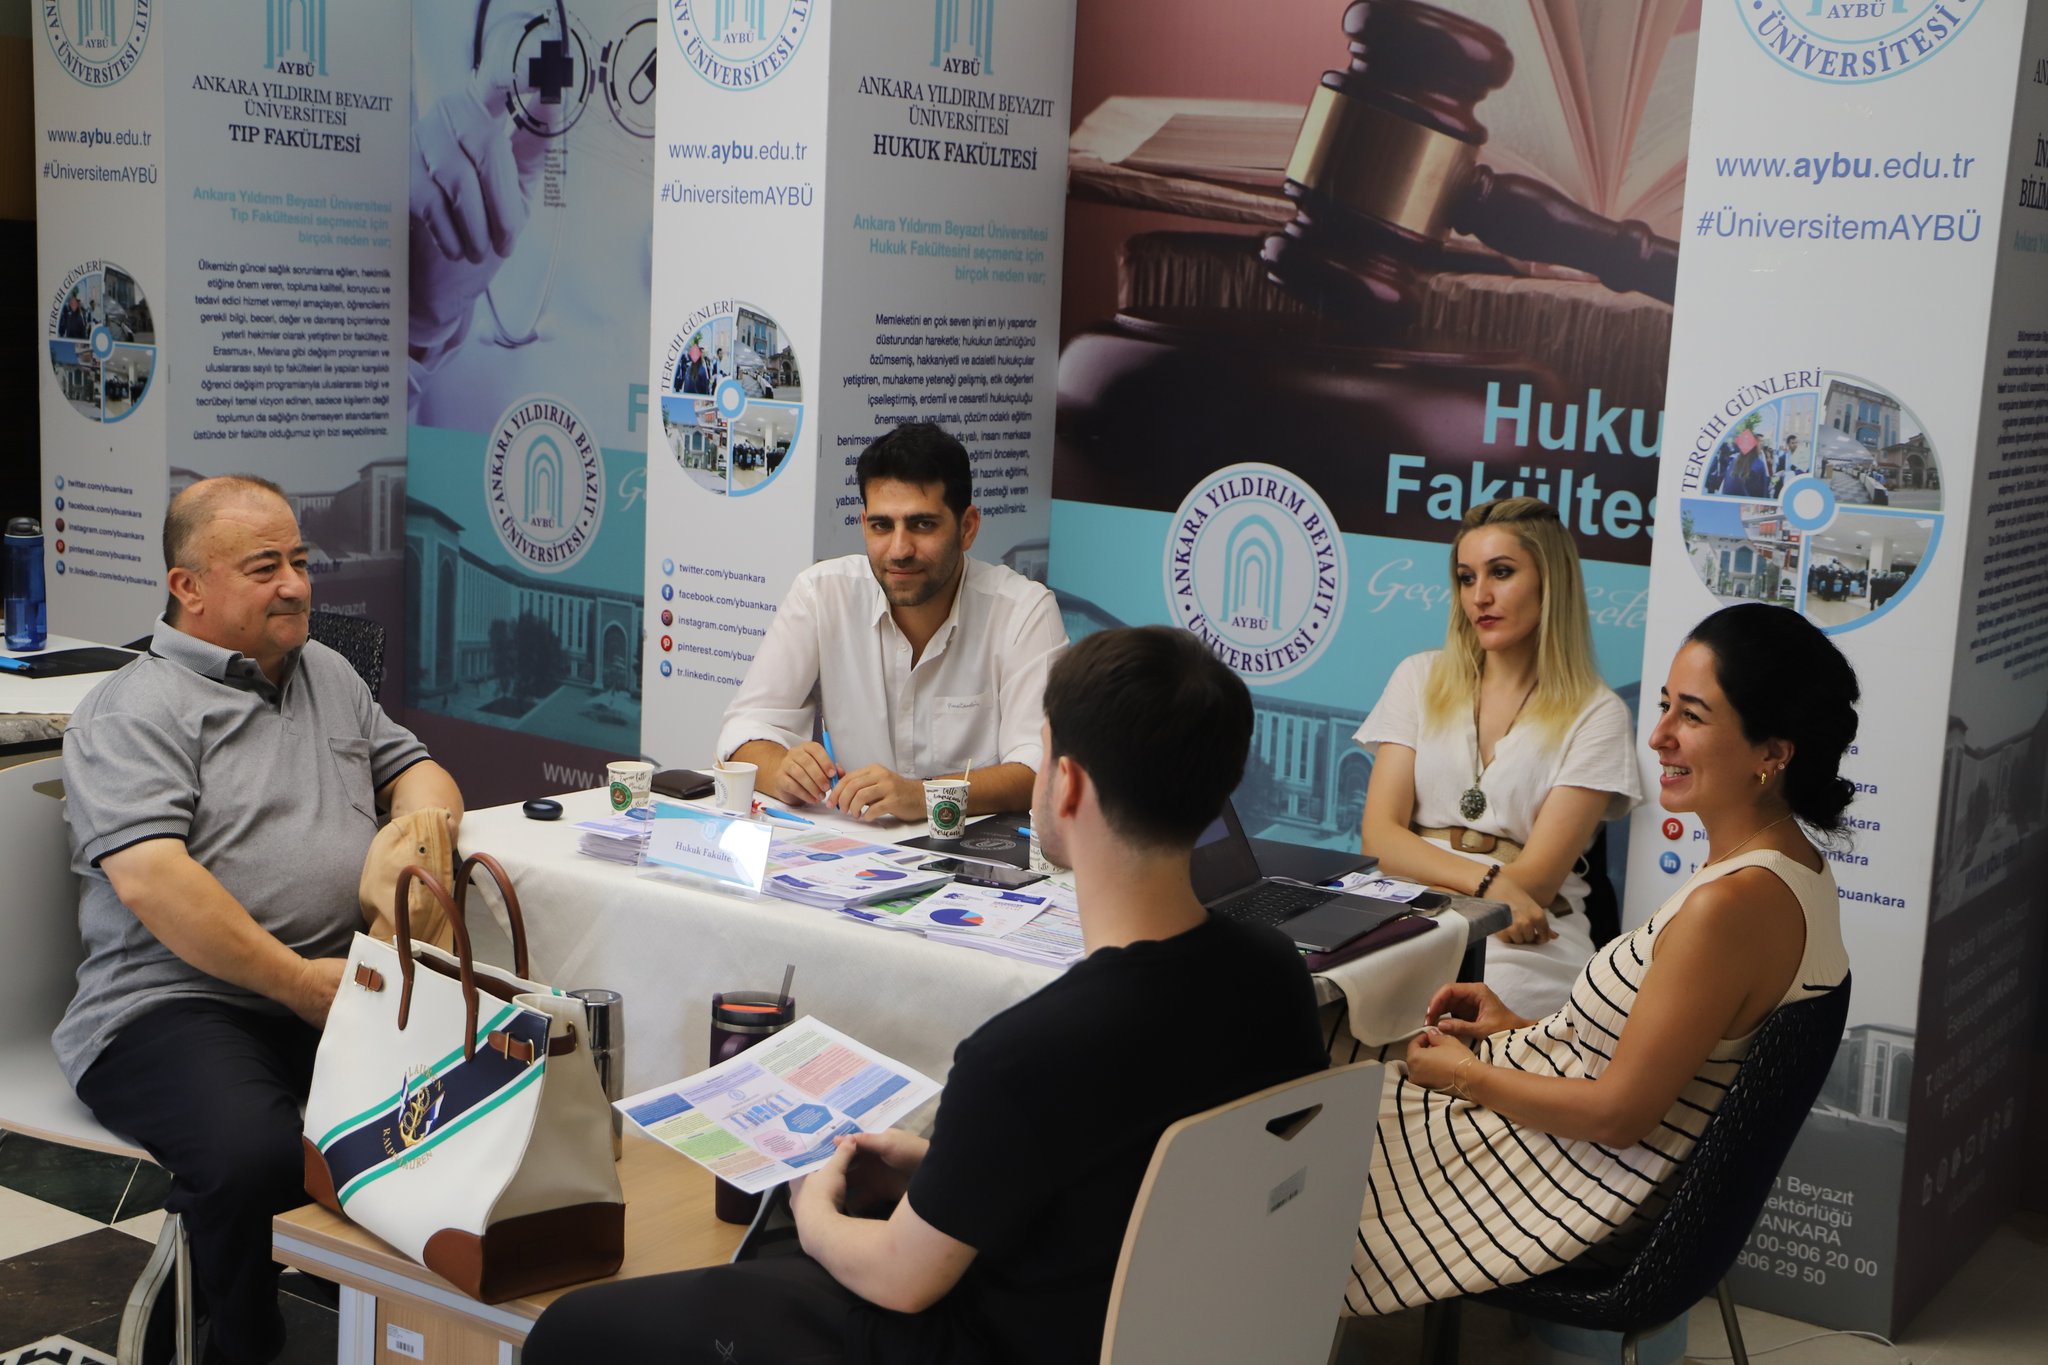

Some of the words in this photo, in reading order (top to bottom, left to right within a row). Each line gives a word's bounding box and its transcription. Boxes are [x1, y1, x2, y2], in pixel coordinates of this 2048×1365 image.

[1827, 0, 1885, 19] AYBÜ
[85, 39, 108, 49] AYBÜ
[723, 31, 755, 44] AYBÜ
[1758, 4, 1961, 77] ÜNİVERSİTESİ
[57, 41, 139, 85] ÜNİVERSİTESİ
[278, 60, 315, 77] AYBÜ
[686, 35, 795, 87] ÜNİVERSİTESİ
[943, 58, 981, 76] AYBÜ
[192, 74, 259, 96] ANKARA
[262, 82, 331, 105] YILDIRIM
[335, 92, 393, 112] BEYAZIT
[858, 76, 924, 101] ANKARA
[928, 84, 995, 112] YILDIRIM
[999, 94, 1055, 118] BEYAZIT
[245, 99, 347, 126] ÜNİVERSİTESİ
[909, 105, 1009, 136] ÜNİVERSİTESİ
[48, 127, 151, 148] www.aybu.edu.tr
[229, 124, 260, 144] TIP
[264, 127, 361, 154] FAKÜLTESİ
[669, 140, 807, 165] www.aybu.edu.tr
[873, 134, 940, 161] HUKUK
[944, 141, 1038, 171] FAKÜLTESİ
[43, 159, 157, 184] #ÜniversitemAYBÜ
[1716, 152, 1975, 184] www.aybu.edu.tr
[661, 183, 813, 207] #ÜniversitemAYBÜ
[854, 214, 895, 232] Ankara
[945, 221, 985, 240] Beyazıt
[988, 220, 1048, 242] Üniversitesi
[1696, 206, 1981, 242] #ÜniversitemAYBÜ
[870, 238, 907, 255] Hukuk
[911, 241, 970, 259] Fakültesini
[973, 247, 1023, 265] seçmeniz
[1026, 247, 1044, 264] için
[955, 265, 991, 282] birçok
[995, 267, 1024, 282] neden
[1028, 269, 1046, 286] var;
[49, 285, 65, 336] TERCİH
[63, 258, 102, 291] GÜNLERİ
[661, 334, 684, 392] TERCİH
[682, 298, 734, 335] GÜNLERİ
[1483, 381, 1665, 458] Huku
[1681, 415, 1727, 492] TERCİH
[1724, 367, 1822, 418] GÜNLERİ
[492, 430, 514, 502] ANKARA
[511, 404, 577, 434] YILDIRIM
[575, 432, 598, 518] BEYAZIT
[68, 480, 133, 495] twitter.com/ybuankara
[1386, 453, 1658, 539] Fakülte
[68, 501, 142, 518] facebook.com/ybuankara
[836, 496, 864, 508] yabanc
[69, 523, 144, 540] instagram.com/ybuankara
[531, 517, 555, 528] AYBÜ
[502, 516, 586, 563] ÜNİVERSİTESİ
[1175, 506, 1208, 597] ANKARA
[1206, 476, 1305, 515] YILDIRIM
[1303, 514, 1337, 620] BEYAZIT
[69, 545, 141, 562] pinterest.com/ybuankara
[69, 566, 157, 586] tr.linkedin.com/edu/ybuankara
[680, 564, 766, 583] twitter.com/ybuankara
[679, 590, 776, 612] facebook.com/ybuankara
[678, 616, 767, 636] instagram.com/ybuank
[1232, 616, 1268, 631] AYBÜ
[678, 642, 754, 662] pinterest.com/ybua
[1188, 613, 1315, 673] ÜNİVERSİTESİ
[678, 668, 744, 686] tr.linkedin.com/e
[675, 841, 701, 855] Hukuk
[1788, 1176, 1854, 1206] Beyazıt
[1764, 1196, 1852, 1228] ektörlüğü
[1760, 1214, 1841, 1246] ANKARA
[1737, 1250, 1769, 1271] 906
[1775, 1260, 1798, 1278] 29
[1803, 1266, 1826, 1285] 50
[1757, 1234, 1820, 1262] 00-906
[1826, 1251, 1849, 1269] 20
[1855, 1258, 1877, 1276] 00
